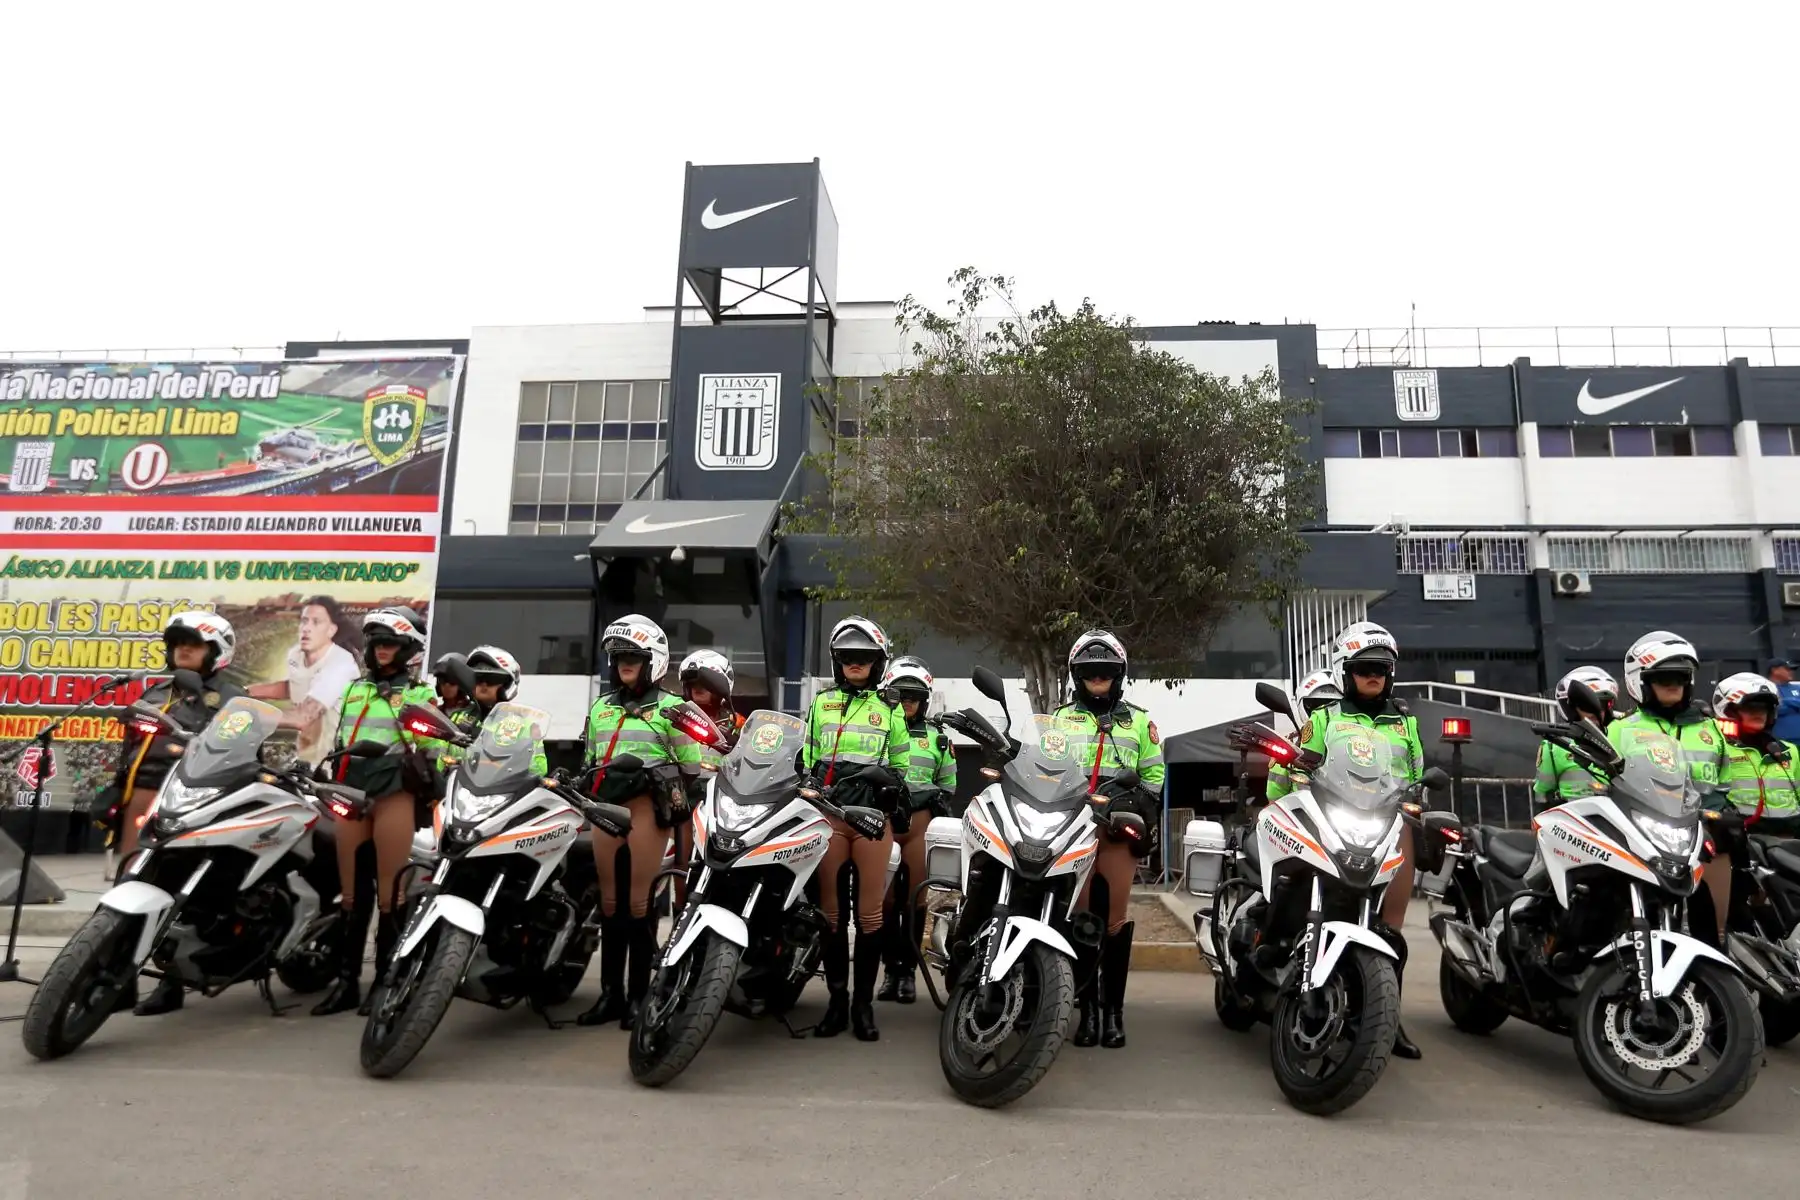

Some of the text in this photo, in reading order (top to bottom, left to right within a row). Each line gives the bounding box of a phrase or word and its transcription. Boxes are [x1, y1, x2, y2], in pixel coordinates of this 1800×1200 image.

[29, 372, 159, 400] Nacional
[161, 372, 208, 399] del
[212, 370, 281, 399] Perú
[712, 378, 769, 388] ALIANZA
[55, 407, 168, 437] Policial
[170, 407, 239, 436] Lima
[703, 403, 714, 440] CLUB
[762, 403, 773, 439] LIMA
[377, 432, 404, 443] LIMA
[131, 451, 160, 486] U
[725, 456, 746, 465] 1901
[14, 516, 423, 533] HORA: 20:30 LUGAR: ESTADIO ALEJANDRO VILLANUEVA
[65, 559, 155, 580] ALIANZA
[158, 560, 208, 580] LIMA
[213, 560, 241, 581] VS
[1458, 580, 1472, 598] 5
[0, 599, 214, 633] BOL ES PASI
[29, 639, 167, 670] CAMBIES
[16, 791, 52, 807] LIG1
[514, 837, 536, 850] FOTO
[1272, 826, 1305, 855] PAPELETAS
[1551, 824, 1567, 840] FOTO
[1567, 834, 1612, 862] PAPELETAS
[772, 849, 793, 862] FOTO
[1300, 922, 1315, 994] POLICIA
